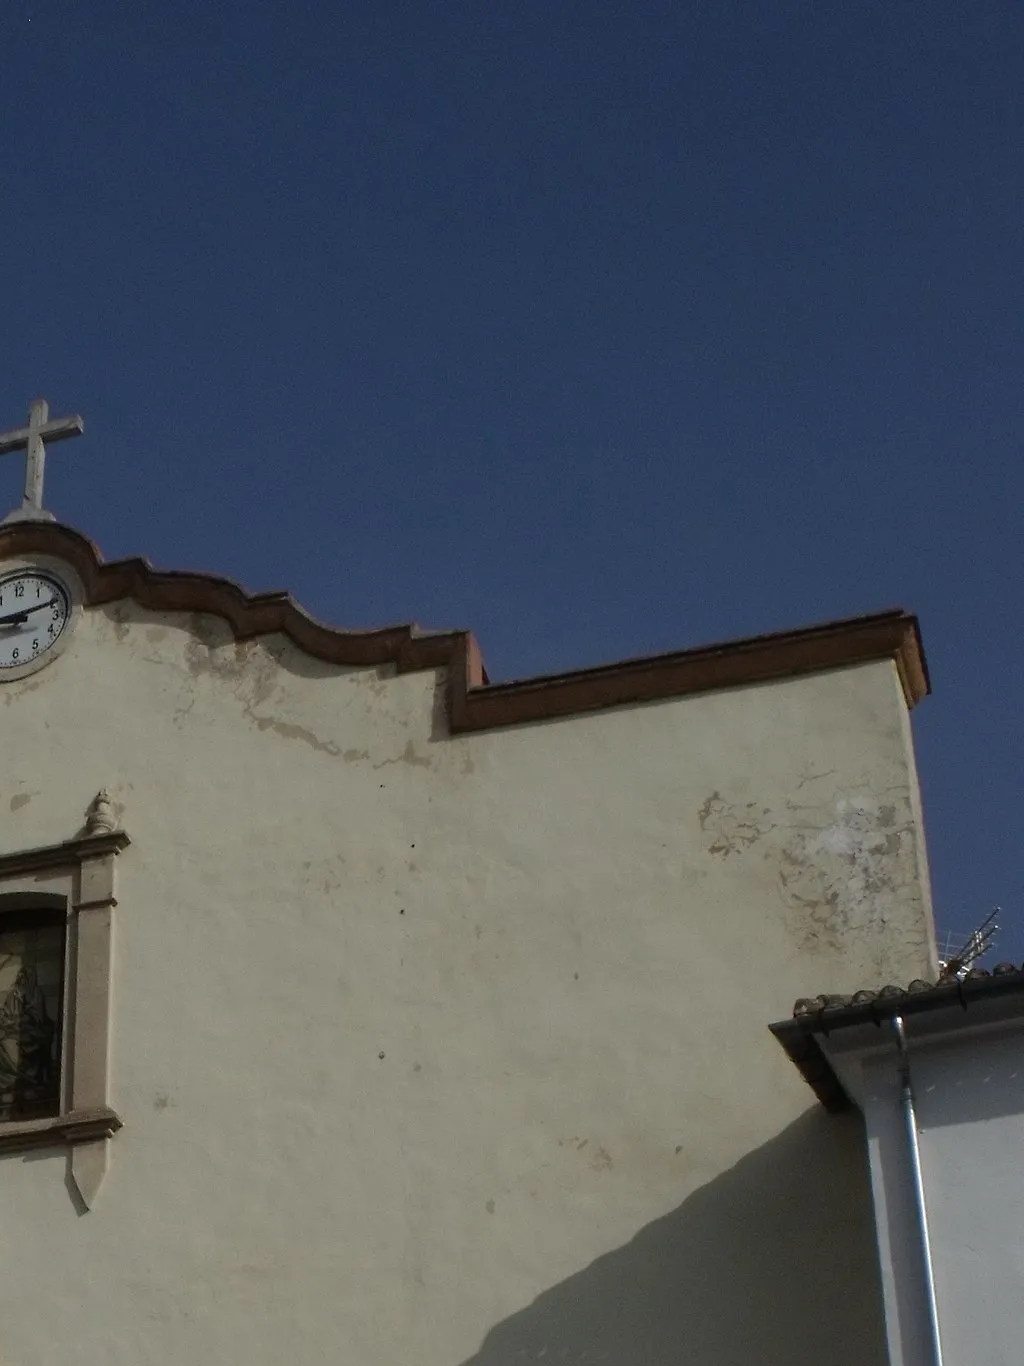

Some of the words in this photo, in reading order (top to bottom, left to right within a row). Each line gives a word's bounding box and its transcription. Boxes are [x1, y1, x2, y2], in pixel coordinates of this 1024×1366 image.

[15, 586, 25, 597] 12
[36, 588, 40, 598] 1
[52, 610, 58, 620] 3
[48, 624, 54, 634] 4
[32, 638, 38, 650] 5
[12, 648, 18, 658] 6
